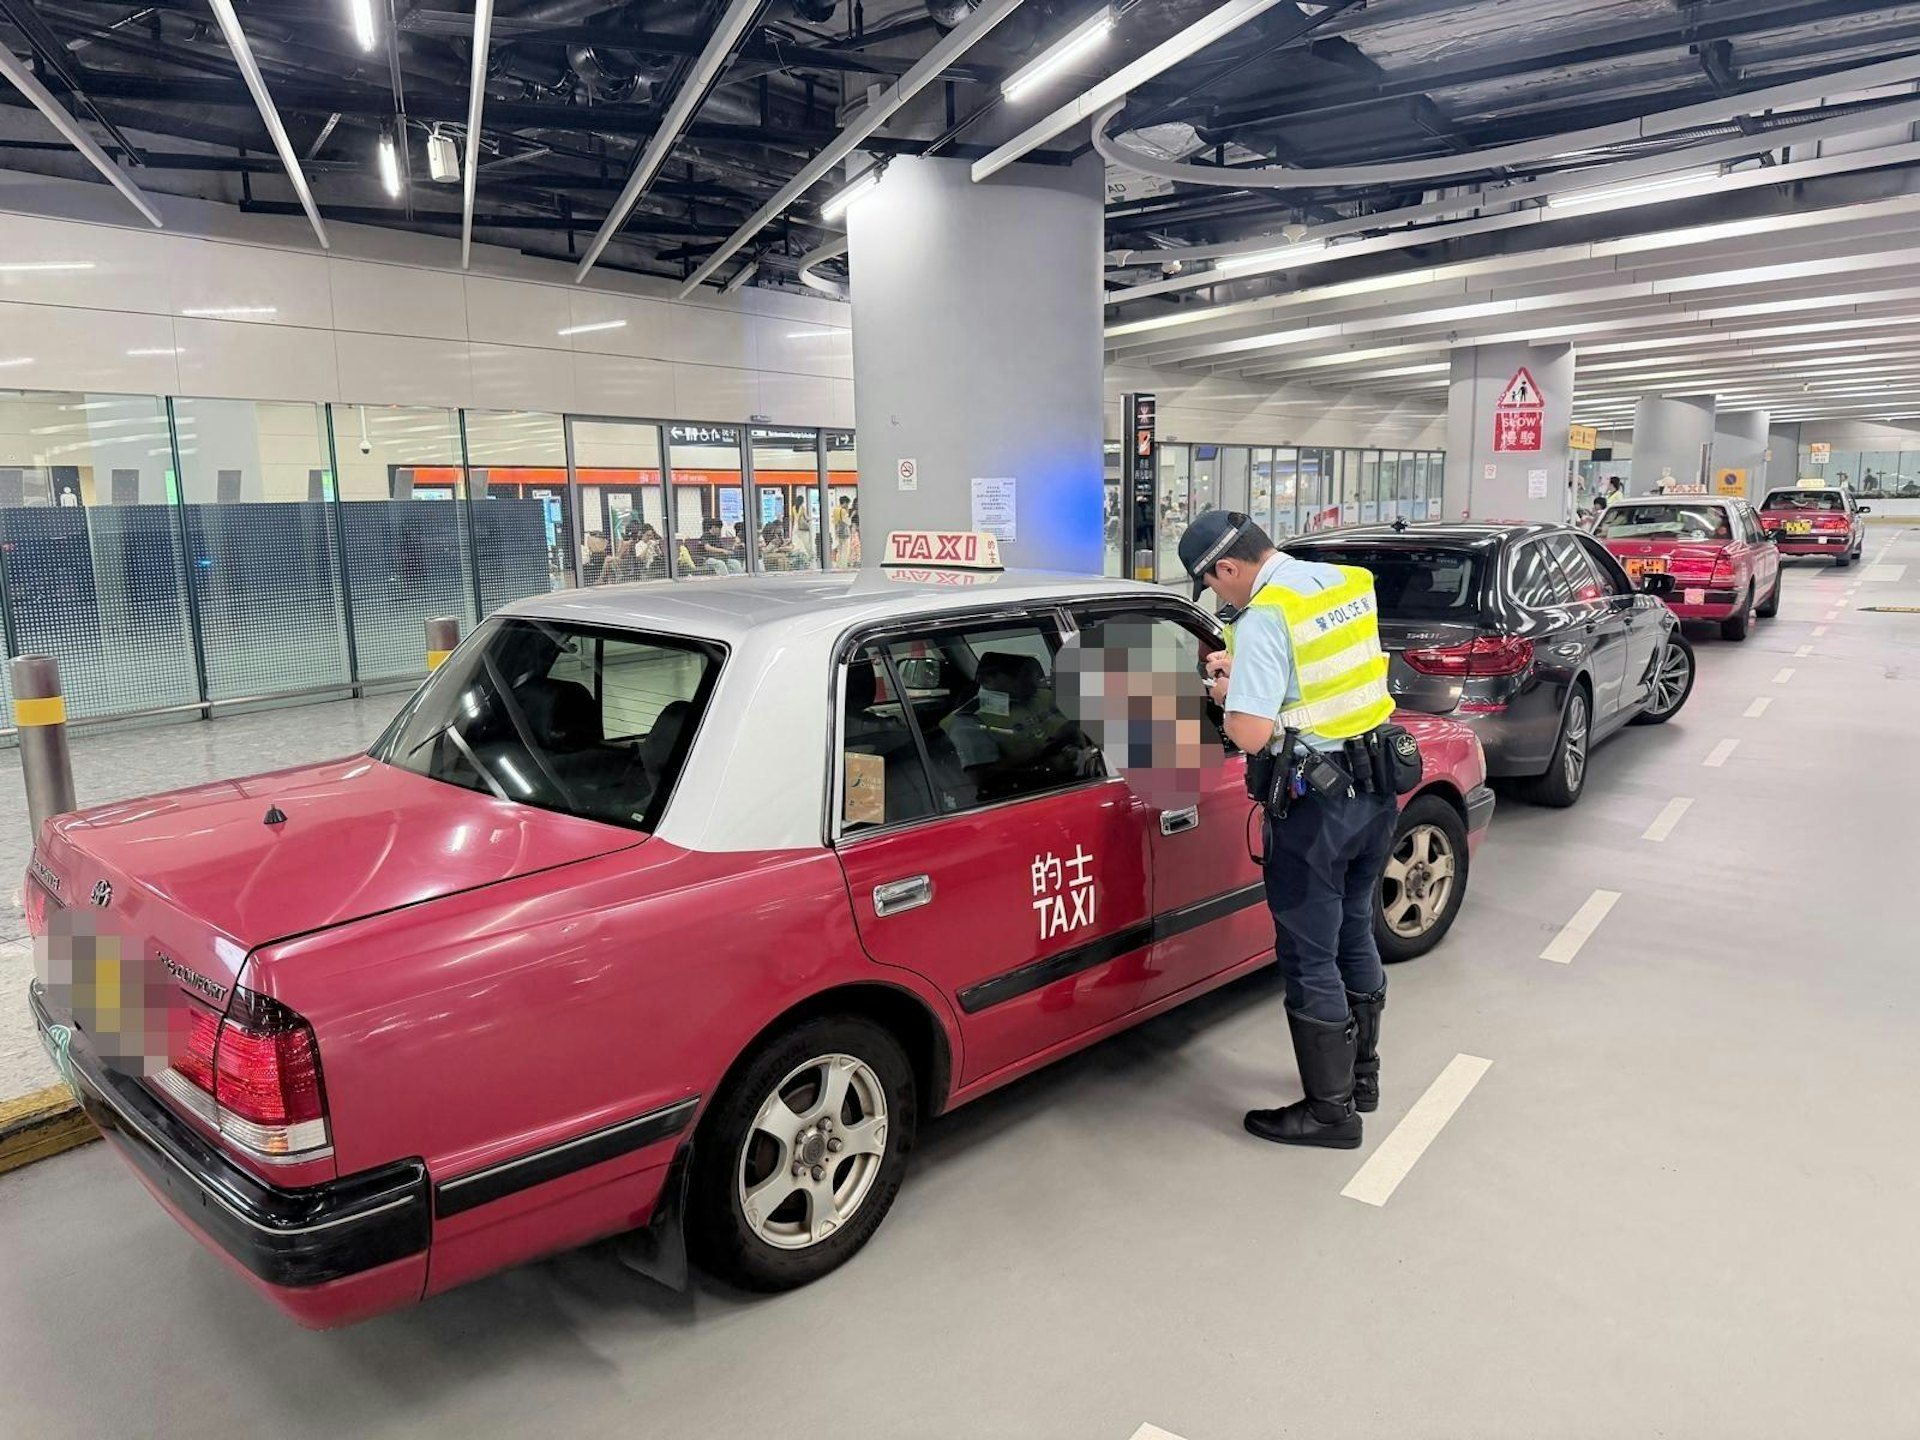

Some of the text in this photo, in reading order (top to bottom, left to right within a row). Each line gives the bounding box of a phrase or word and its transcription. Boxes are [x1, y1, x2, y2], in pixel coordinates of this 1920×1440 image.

[1503, 417, 1536, 427] SLOW
[1667, 485, 1703, 493] TAXI
[892, 534, 977, 561] TAXI
[1328, 601, 1363, 626] POLCE
[1031, 844, 1094, 896] 的士
[1032, 885, 1095, 940] TAXI
[175, 964, 229, 1002] COMFORT
